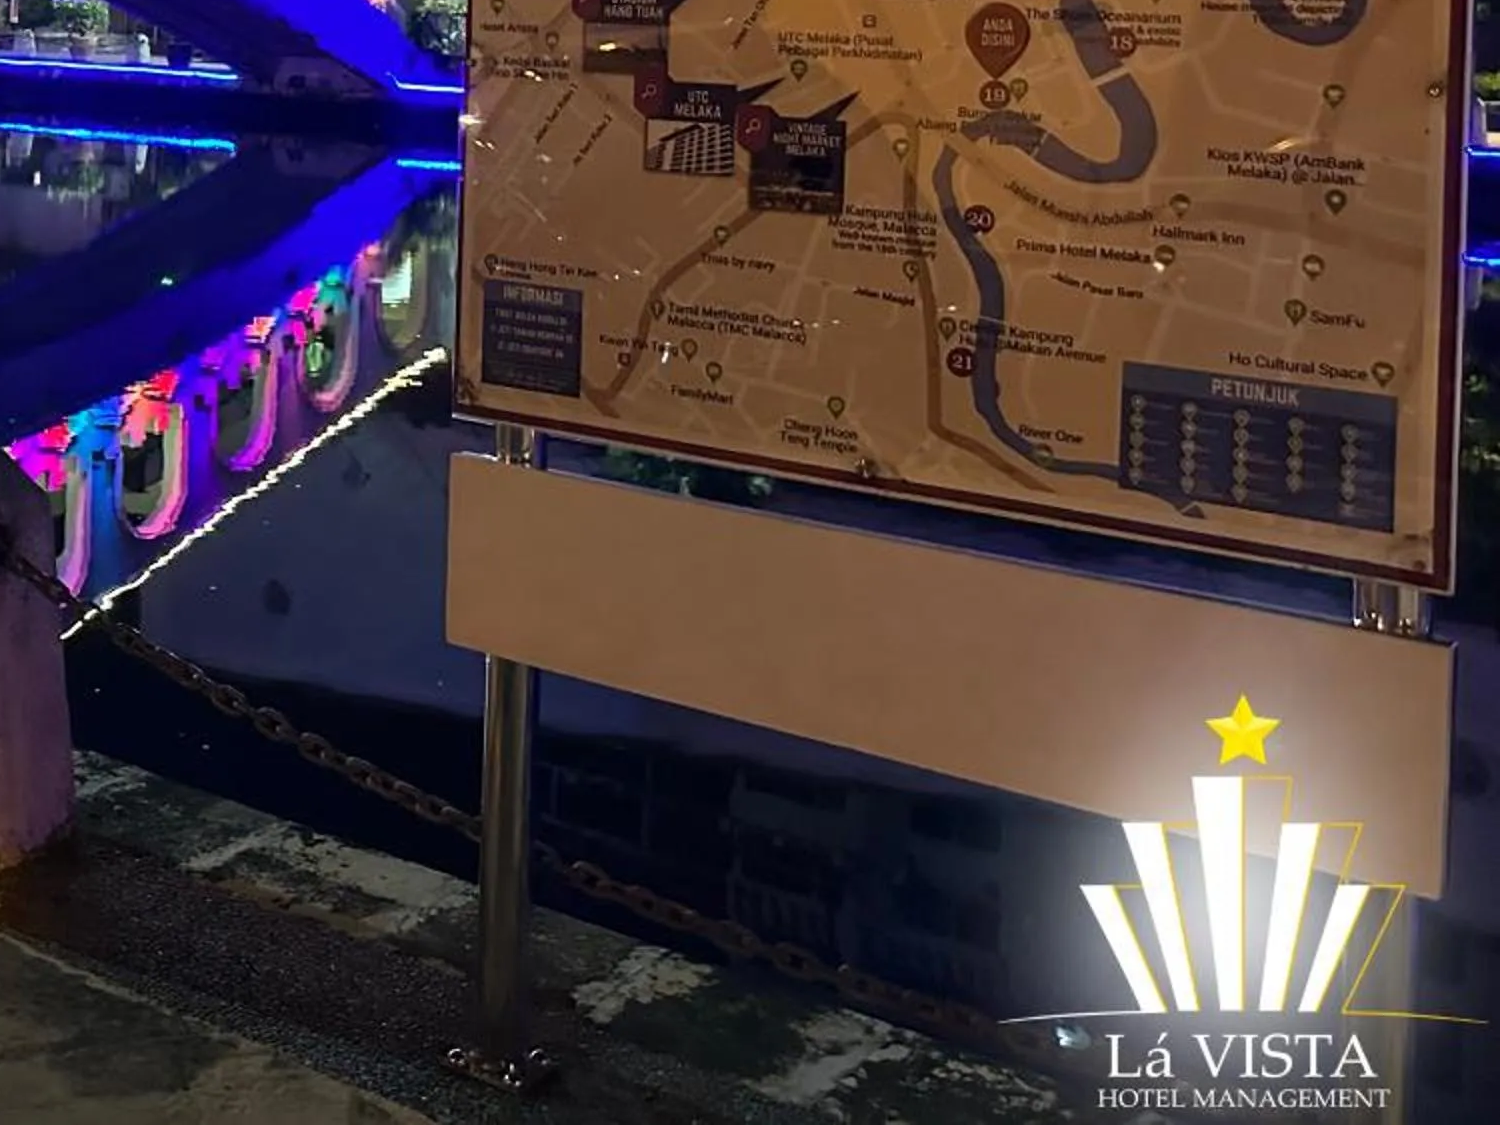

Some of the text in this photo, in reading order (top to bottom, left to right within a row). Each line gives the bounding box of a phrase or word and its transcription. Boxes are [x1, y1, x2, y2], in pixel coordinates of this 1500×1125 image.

[603, 4, 664, 20] HANG TUAH
[1025, 7, 1182, 25] The Oceanarium
[982, 17, 1014, 33] ANDA
[777, 31, 894, 47] UTC Melaka (Pusat
[981, 33, 1015, 47] DISINI
[1110, 35, 1133, 50] 18
[686, 90, 709, 103] UTC
[983, 87, 1006, 103] 19
[673, 102, 722, 119] MELAKA
[788, 122, 827, 135] VINTAGE
[785, 144, 826, 157] MELAKA
[1206, 147, 1366, 172] Kios KWSP (AmBank
[1227, 163, 1288, 184] Melaka)
[1003, 179, 1038, 206] Jalan
[1092, 208, 1155, 227] Abdullah
[845, 204, 906, 222] Kampung
[964, 211, 993, 227] 20
[883, 221, 937, 237] Malacca
[1151, 223, 1247, 246] Hallmark Inn
[1015, 237, 1152, 265] Prima Hotel Melaka
[503, 283, 564, 307] INFORMASI
[668, 302, 699, 316] Tamil
[701, 305, 759, 324] Methodist
[1308, 309, 1366, 329] SamFu
[667, 316, 808, 347] Malacca (TMC Malacca)
[1009, 325, 1075, 348] Kampung
[952, 355, 973, 370] 21
[1054, 345, 1107, 364] Avenue
[1228, 351, 1368, 382] Ho Cultural Space
[670, 384, 735, 406] FamilyMart
[1210, 377, 1301, 407] PETUNJUK
[783, 418, 859, 441] Cheng Hoon
[1018, 424, 1084, 445] River One
[780, 430, 859, 455] Teng Temple
